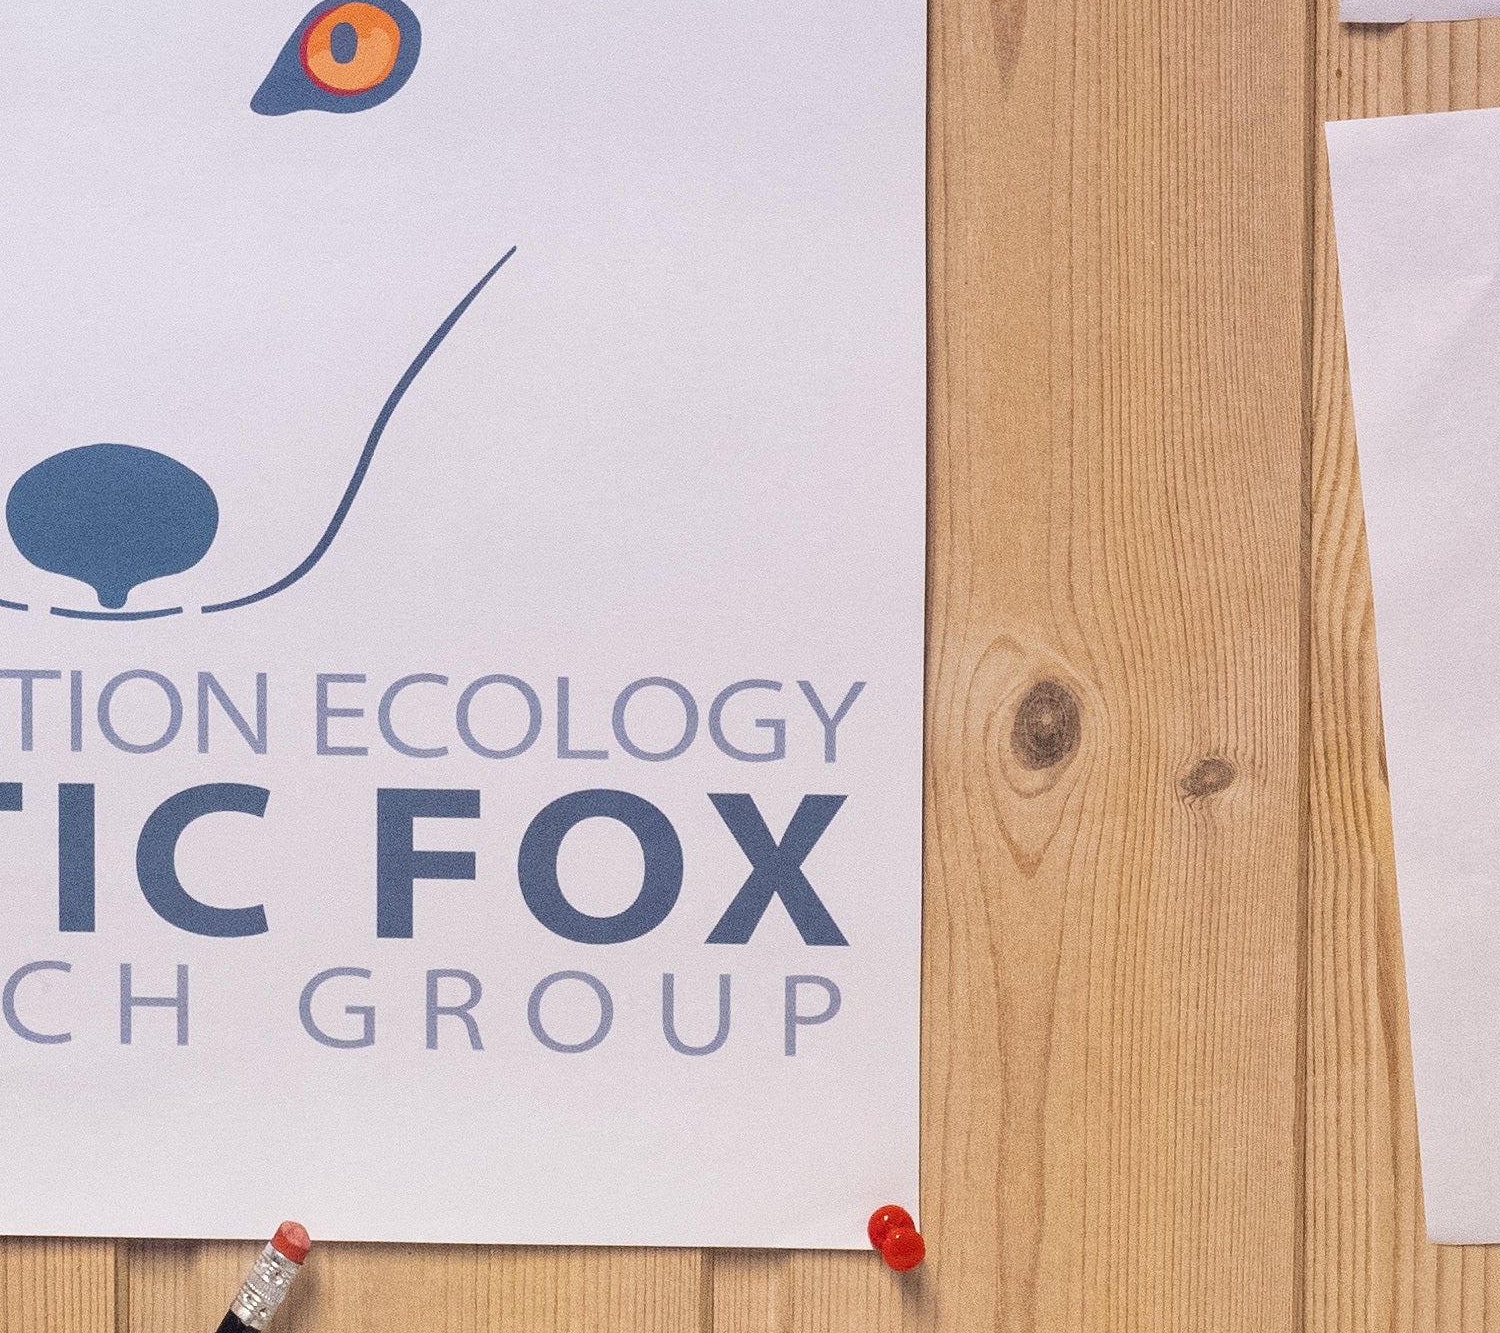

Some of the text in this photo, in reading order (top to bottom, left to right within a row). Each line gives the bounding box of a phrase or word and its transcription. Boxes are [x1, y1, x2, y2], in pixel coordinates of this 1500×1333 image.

[315, 672, 867, 764] ECOLOGY
[376, 787, 850, 947] FOX
[298, 966, 842, 1057] GROUP
